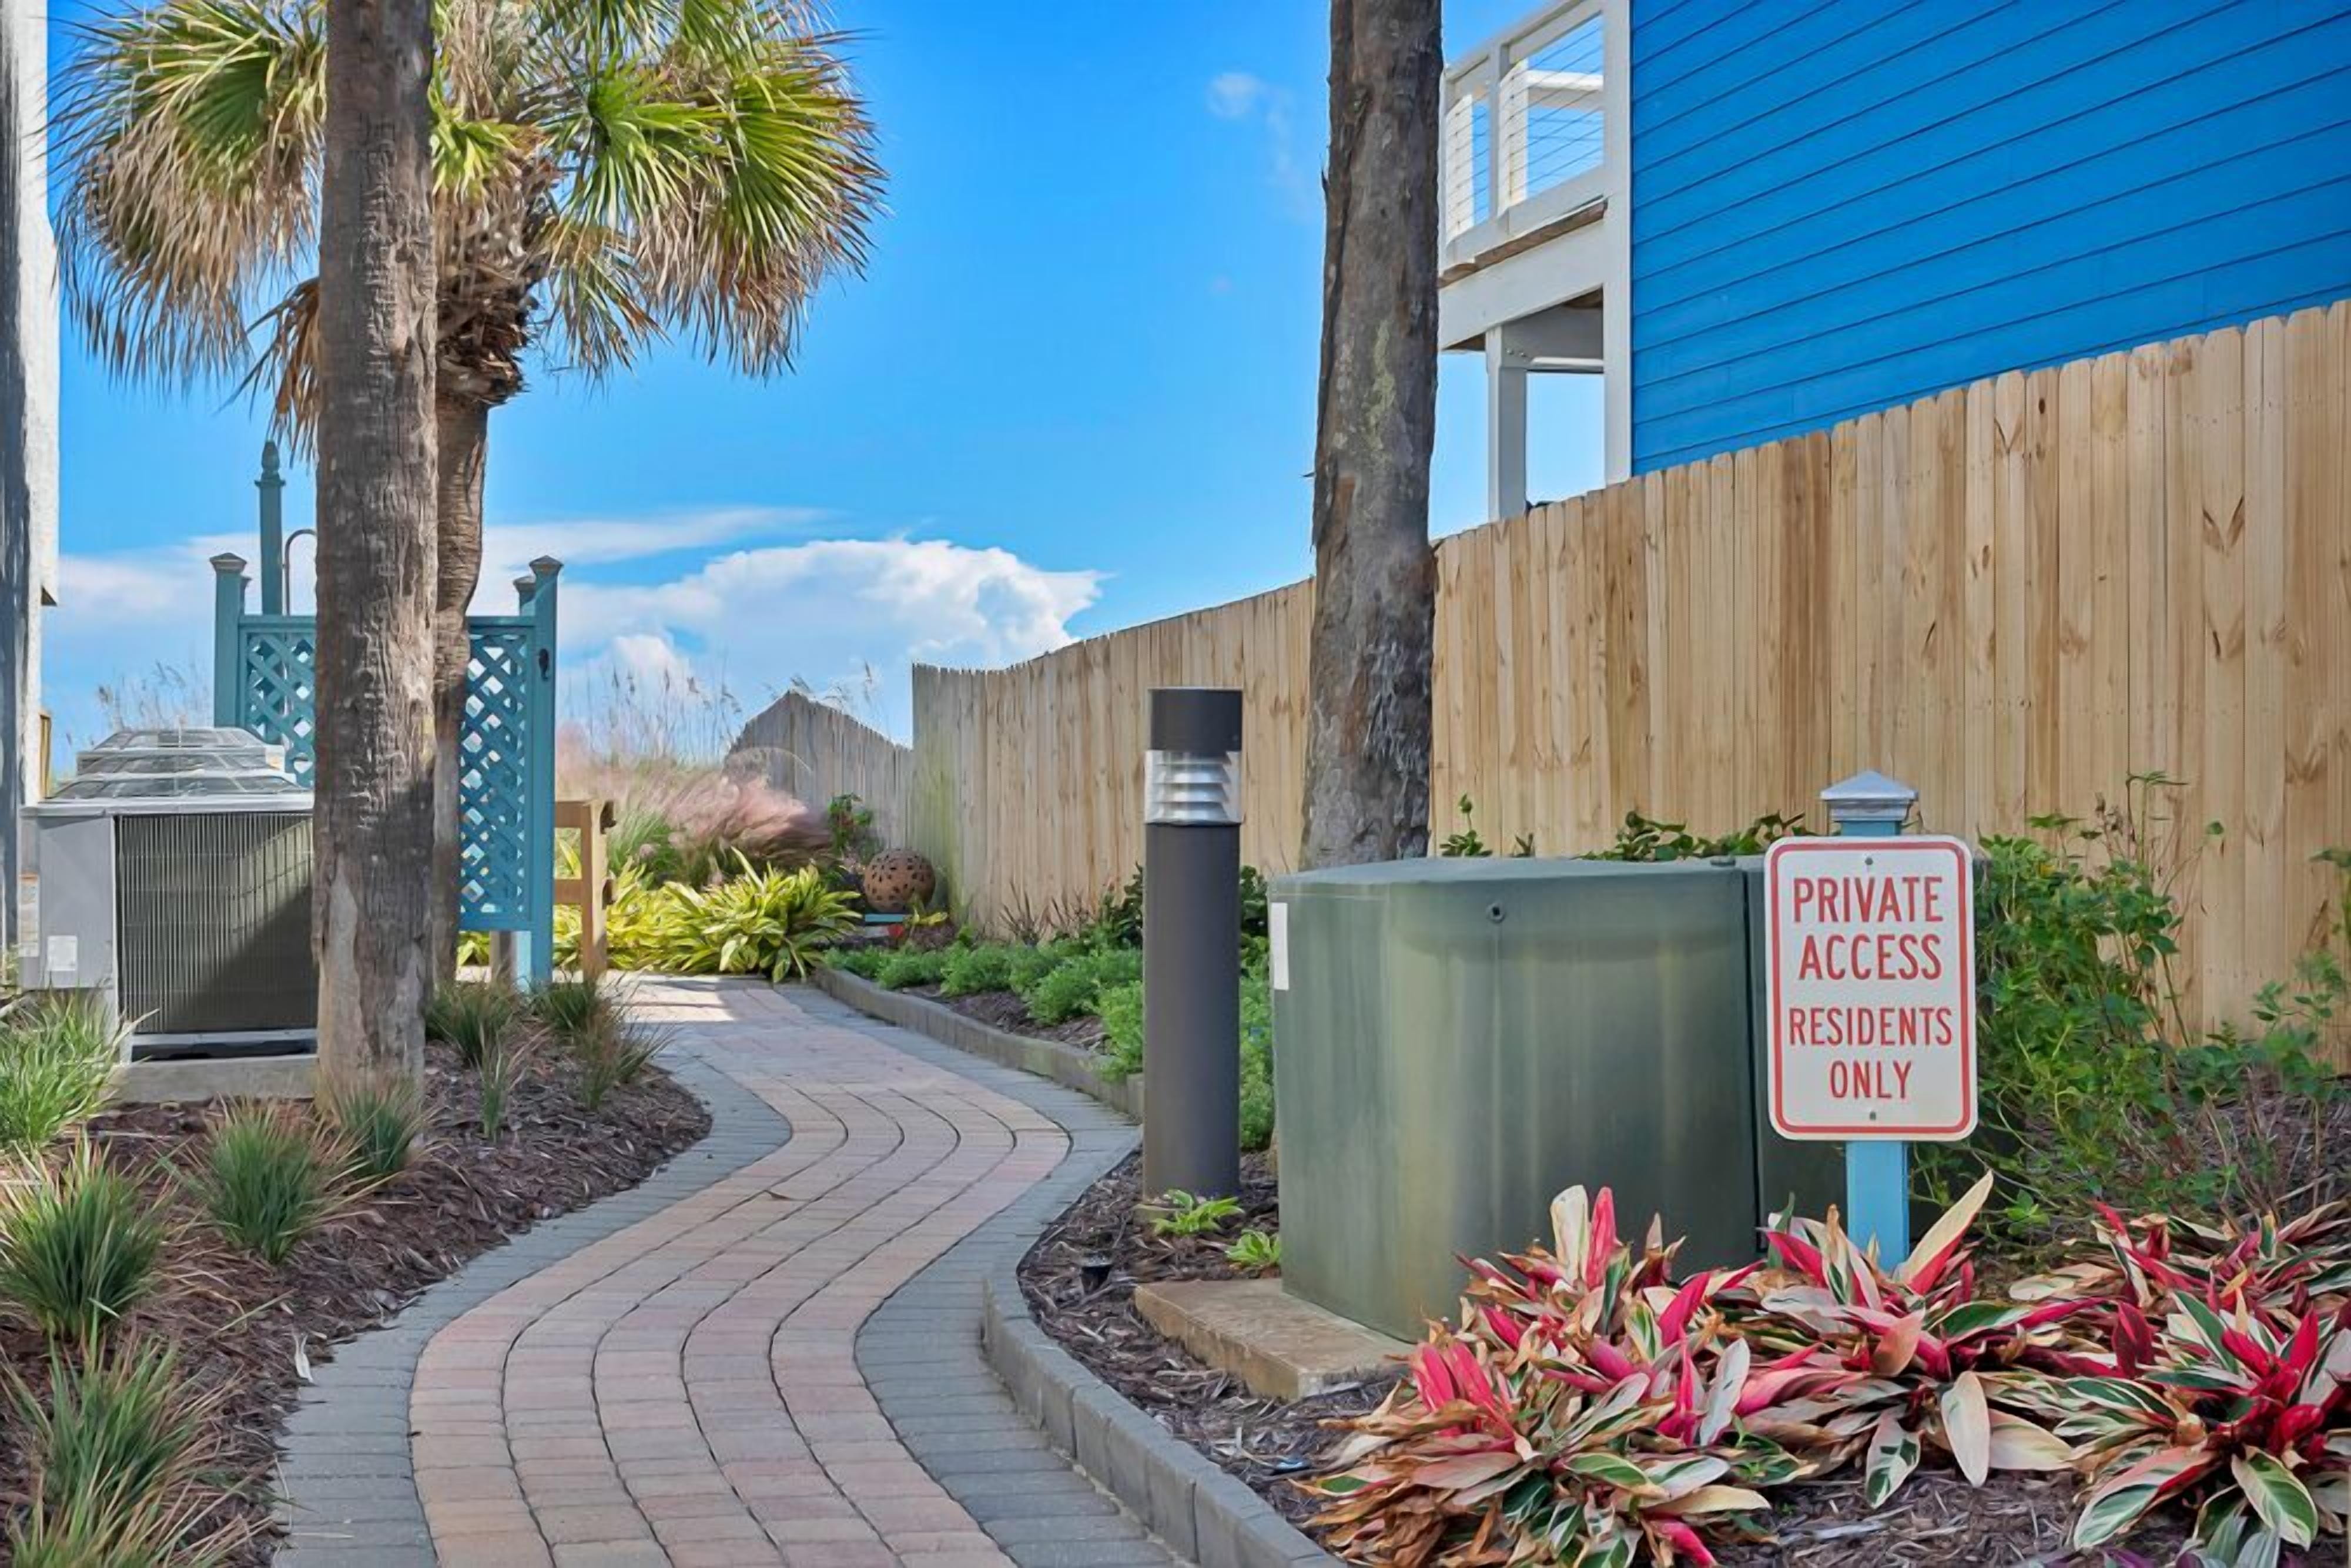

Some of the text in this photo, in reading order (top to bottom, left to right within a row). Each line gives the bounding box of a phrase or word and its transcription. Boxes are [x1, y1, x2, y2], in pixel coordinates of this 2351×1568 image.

[1793, 876, 1943, 923] PRIVATE
[1799, 934, 1941, 980] ACCESS
[1789, 1007, 1953, 1046] RESIDENTS
[1830, 1060, 1912, 1099] ONLY
